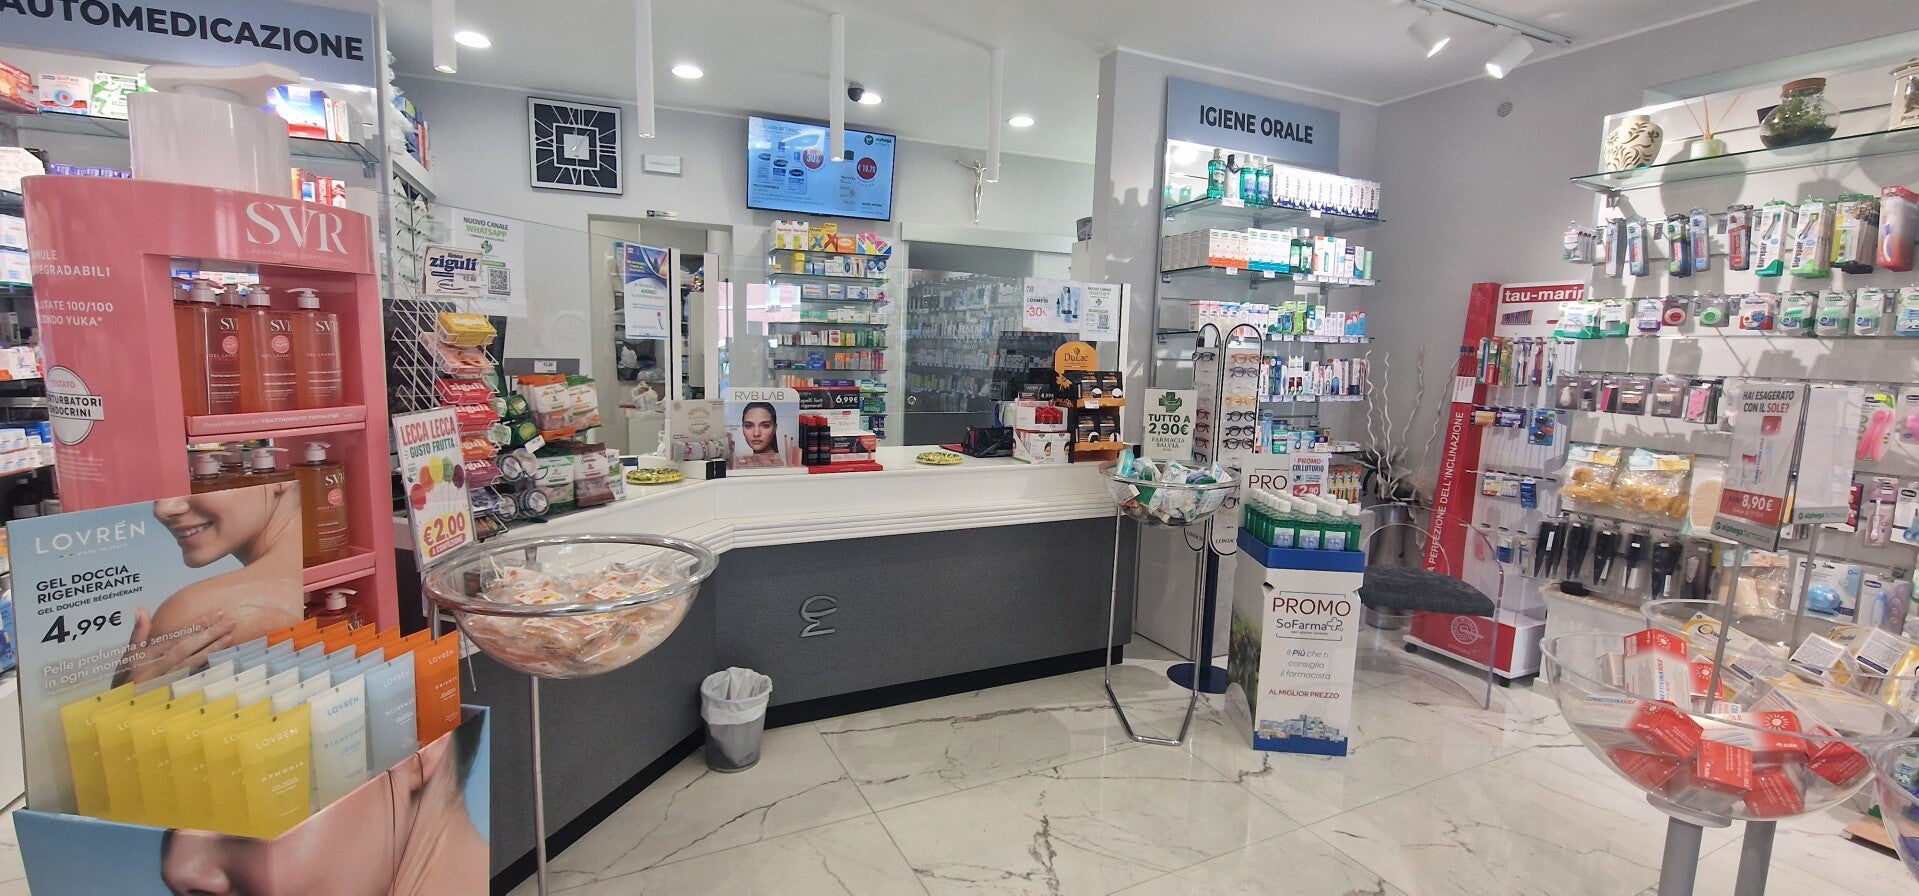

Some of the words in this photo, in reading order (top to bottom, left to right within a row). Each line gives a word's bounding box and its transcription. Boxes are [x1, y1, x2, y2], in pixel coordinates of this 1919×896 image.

[1200, 105, 1256, 134] IGIENE
[1261, 117, 1314, 144] ORALE
[246, 201, 348, 255] SVR
[66, 301, 114, 312] 100/100
[735, 391, 759, 401] RVB
[762, 391, 785, 401] LAB
[835, 394, 859, 405] 6,99€
[1743, 391, 1754, 400] HAI
[1755, 390, 1795, 401] ESAGERATO
[1743, 402, 1758, 413] CON
[1759, 402, 1766, 413] IL
[1767, 402, 1790, 413] SOLE?
[1148, 413, 1181, 424] TUTTO
[1183, 415, 1191, 424] A
[400, 419, 430, 447] LECCA
[429, 415, 456, 441] LECCA
[1148, 422, 1189, 436] 2,90€
[1151, 436, 1185, 444] FARMACIA
[1155, 441, 1179, 449] SALVIA
[409, 444, 431, 459] GUSTO
[432, 437, 456, 455] FRUTTA
[1297, 457, 1322, 465] PROMO
[1292, 464, 1325, 473] COLLUTORIO
[1428, 506, 1447, 565] PERFEZIONE
[1440, 411, 1465, 505] DELL'INCLINAZIONE
[1741, 494, 1774, 513] 8,90€
[35, 520, 147, 555] LOVRÉN
[36, 577, 68, 592] GEL
[71, 565, 130, 585] DOCCIA
[37, 573, 141, 604] RIGENERANTE
[37, 607, 55, 616] GEL
[56, 598, 91, 612] DOUCHE
[1272, 597, 1351, 617] PROMO
[41, 610, 123, 644] 4,99€
[44, 661, 74, 677] Pelle
[78, 643, 137, 666] profumata
[140, 639, 148, 648] e
[1292, 648, 1306, 657] Più
[1306, 649, 1322, 658] che
[44, 679, 56, 688] in
[60, 669, 89, 684] ogni
[92, 652, 146, 674] momento
[1288, 659, 1326, 670] consiglia
[1280, 669, 1286, 677] il
[1285, 669, 1332, 680] farmacista
[1268, 688, 1278, 697] AL
[1278, 689, 1310, 698] MIGLIOR
[1310, 691, 1340, 700] PREZZO
